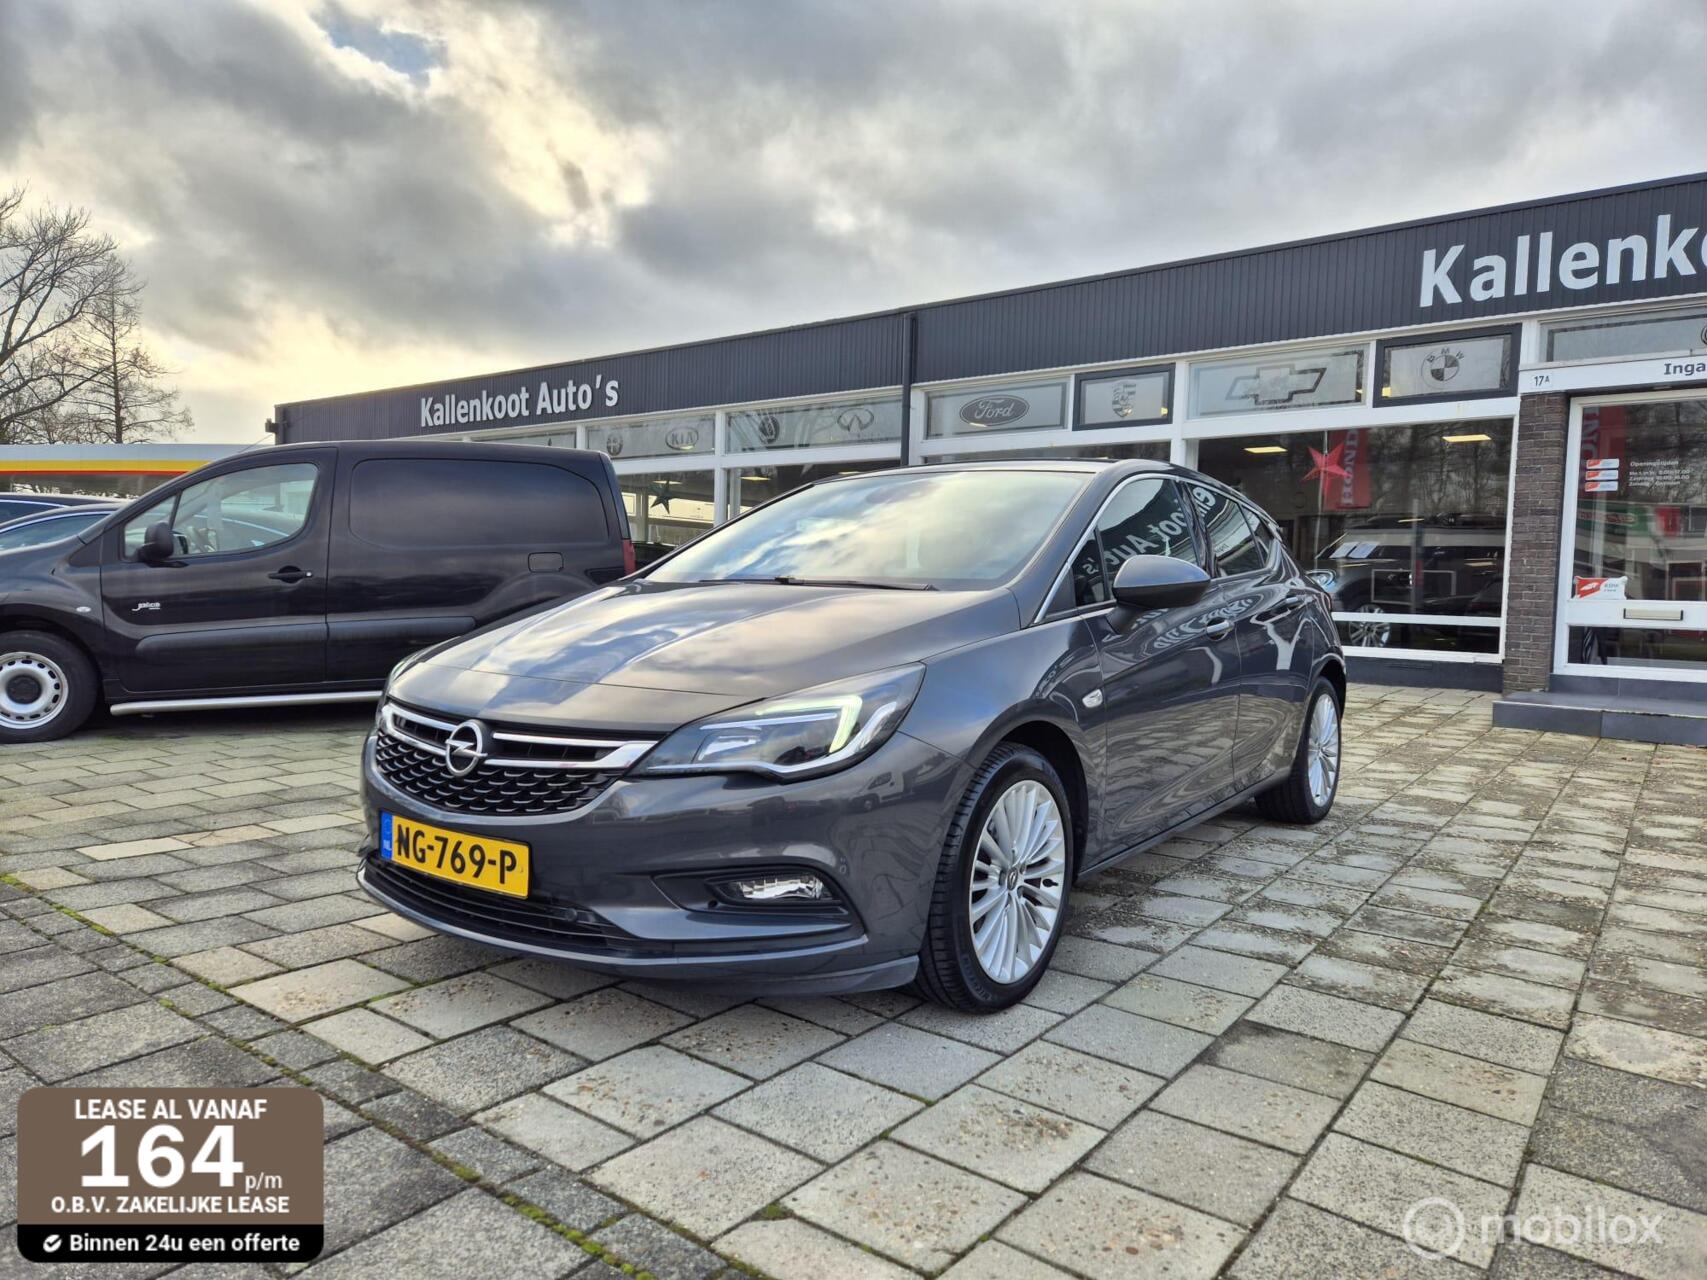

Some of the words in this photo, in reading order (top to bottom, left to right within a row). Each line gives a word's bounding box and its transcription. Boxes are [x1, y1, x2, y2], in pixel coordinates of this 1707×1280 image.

[1419, 213, 1707, 308] Kallenk
[1663, 362, 1706, 376] Inga
[420, 385, 530, 427] Kallenkoot
[536, 374, 619, 416] Auto's
[972, 398, 1016, 419] Ford
[669, 431, 697, 448] KIA
[397, 823, 517, 885] NG-769-P
